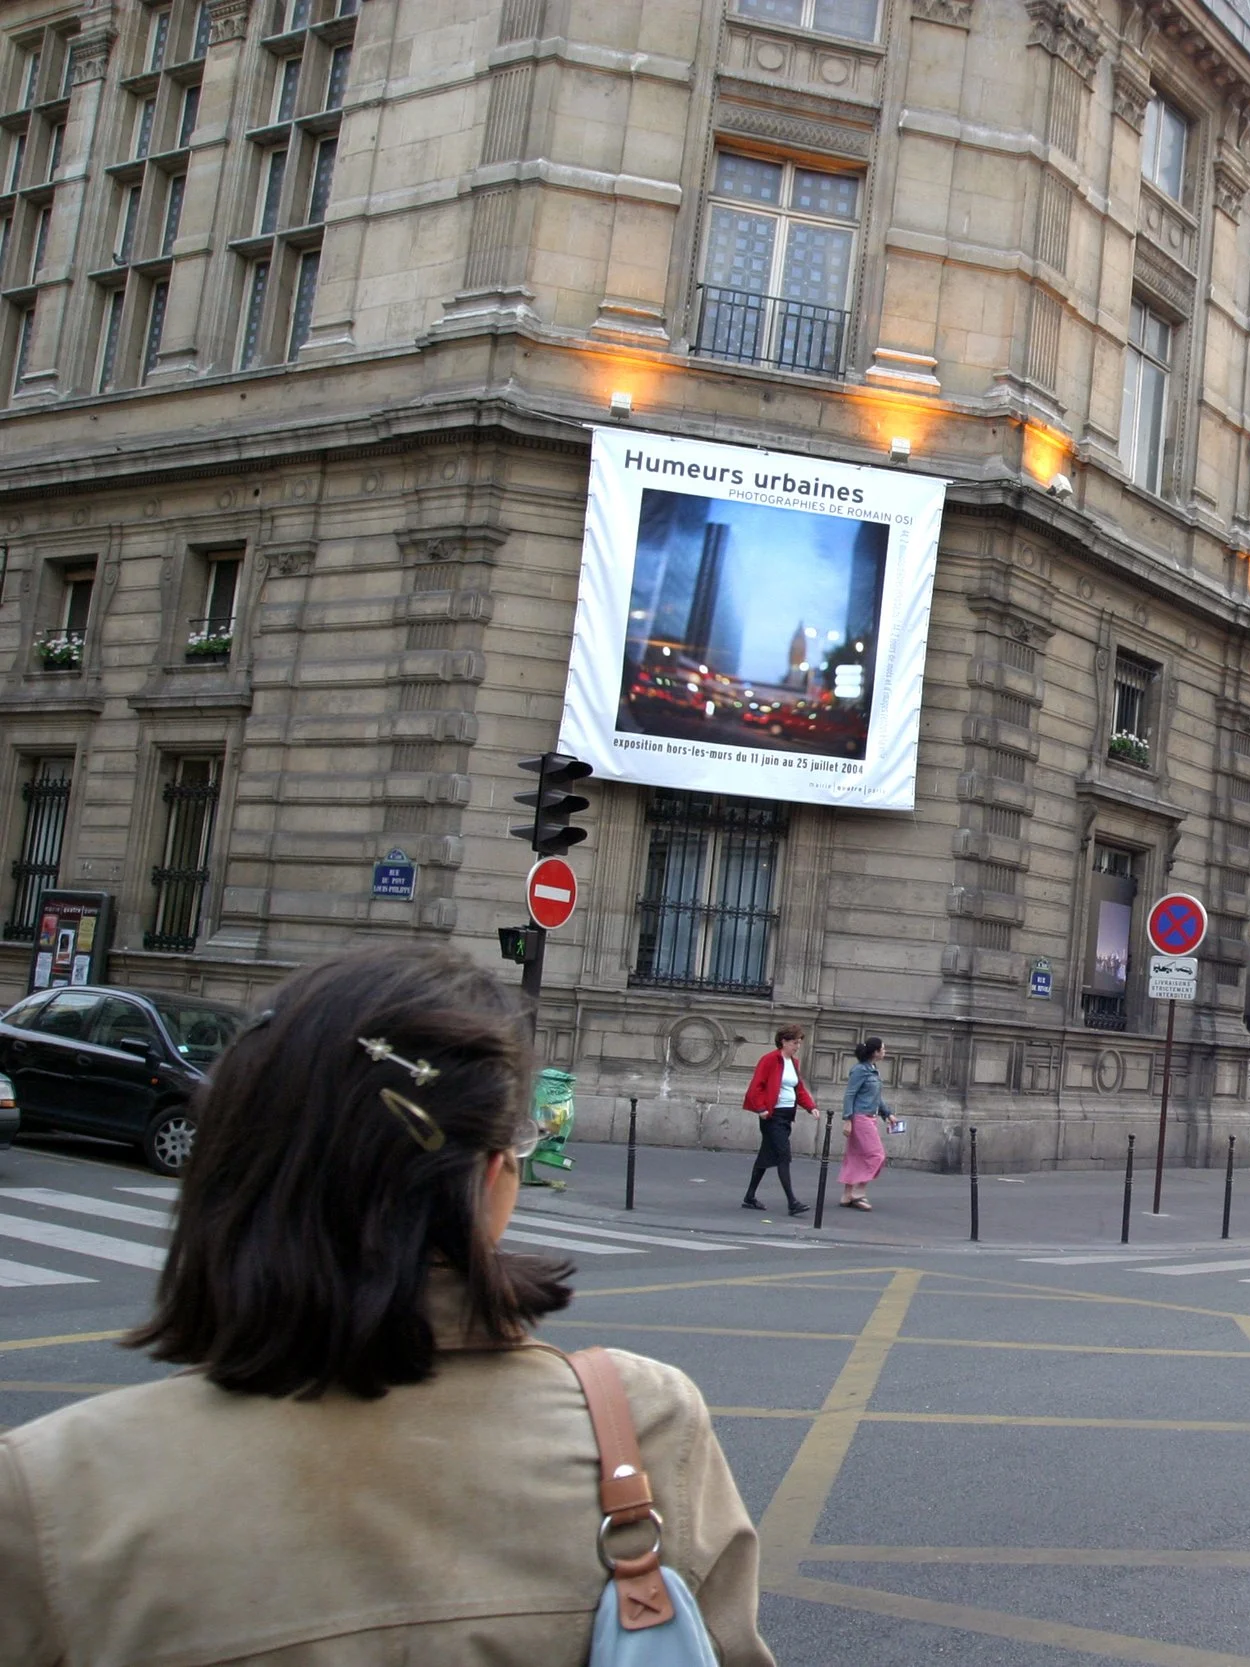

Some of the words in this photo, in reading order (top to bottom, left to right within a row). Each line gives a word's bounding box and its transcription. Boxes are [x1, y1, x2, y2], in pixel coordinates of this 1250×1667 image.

[624, 449, 744, 485] Humeurs
[754, 471, 865, 504] urbaines
[728, 488, 826, 512] PHOTOGRAPHIES
[829, 504, 845, 515] DE
[847, 506, 893, 523] ROMAIN
[613, 737, 663, 752] exposition
[666, 742, 732, 761] hors-les-murs
[736, 753, 747, 763] du
[750, 753, 759, 764] 11
[761, 755, 779, 768] juin
[782, 759, 794, 769] au
[796, 758, 808, 769] 25
[810, 760, 838, 774] juillet
[841, 763, 864, 775] 2004
